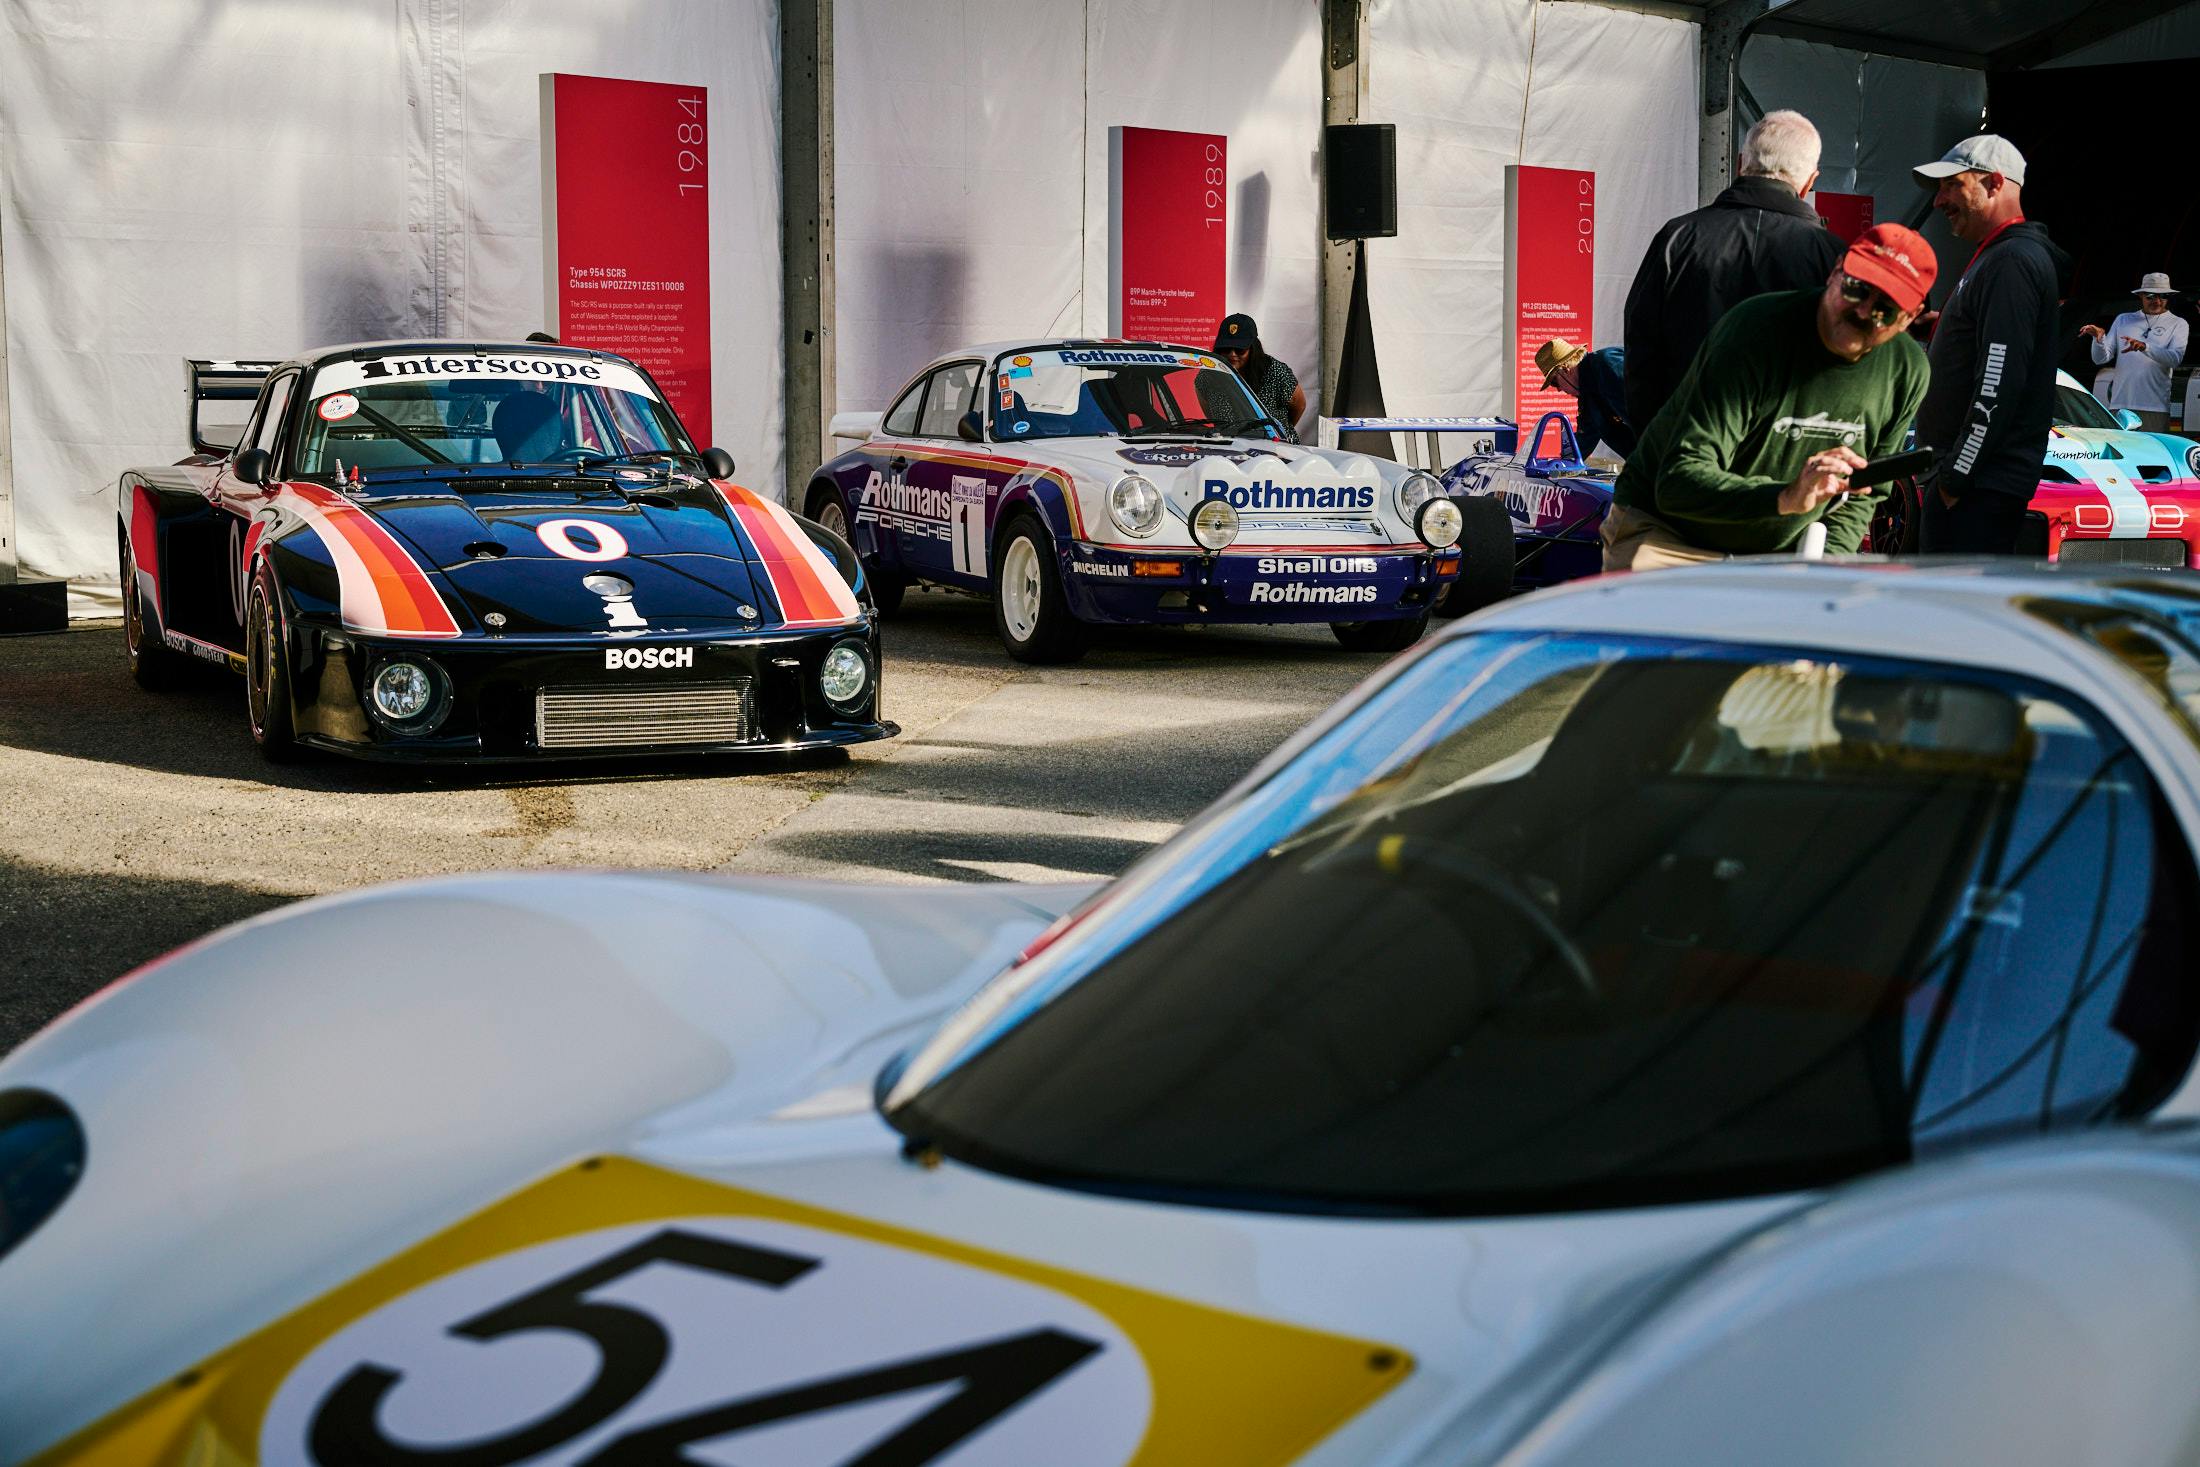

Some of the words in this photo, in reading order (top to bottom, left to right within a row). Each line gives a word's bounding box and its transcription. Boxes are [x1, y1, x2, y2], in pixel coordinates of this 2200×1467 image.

[678, 95, 703, 196] 1984
[1205, 144, 1224, 229] 1989
[1578, 178, 1593, 254] 2019
[570, 267, 588, 278] Type
[590, 268, 604, 277] 954
[606, 268, 626, 278] SCRS
[570, 280, 598, 289] Chassis
[1058, 351, 1177, 363] Rothmans
[2047, 450, 2100, 460] hampion
[860, 470, 950, 520] Rothmans
[1204, 480, 1374, 508] Rothmans
[856, 511, 951, 541] PORSCHE
[536, 519, 628, 562] 0
[961, 505, 971, 572] 1
[1072, 562, 1128, 576] MICHELIN
[1258, 558, 1326, 574] Shell
[1250, 582, 1378, 603] Rothmans
[166, 632, 186, 653] BOSCH
[606, 647, 693, 669] BOSCH
